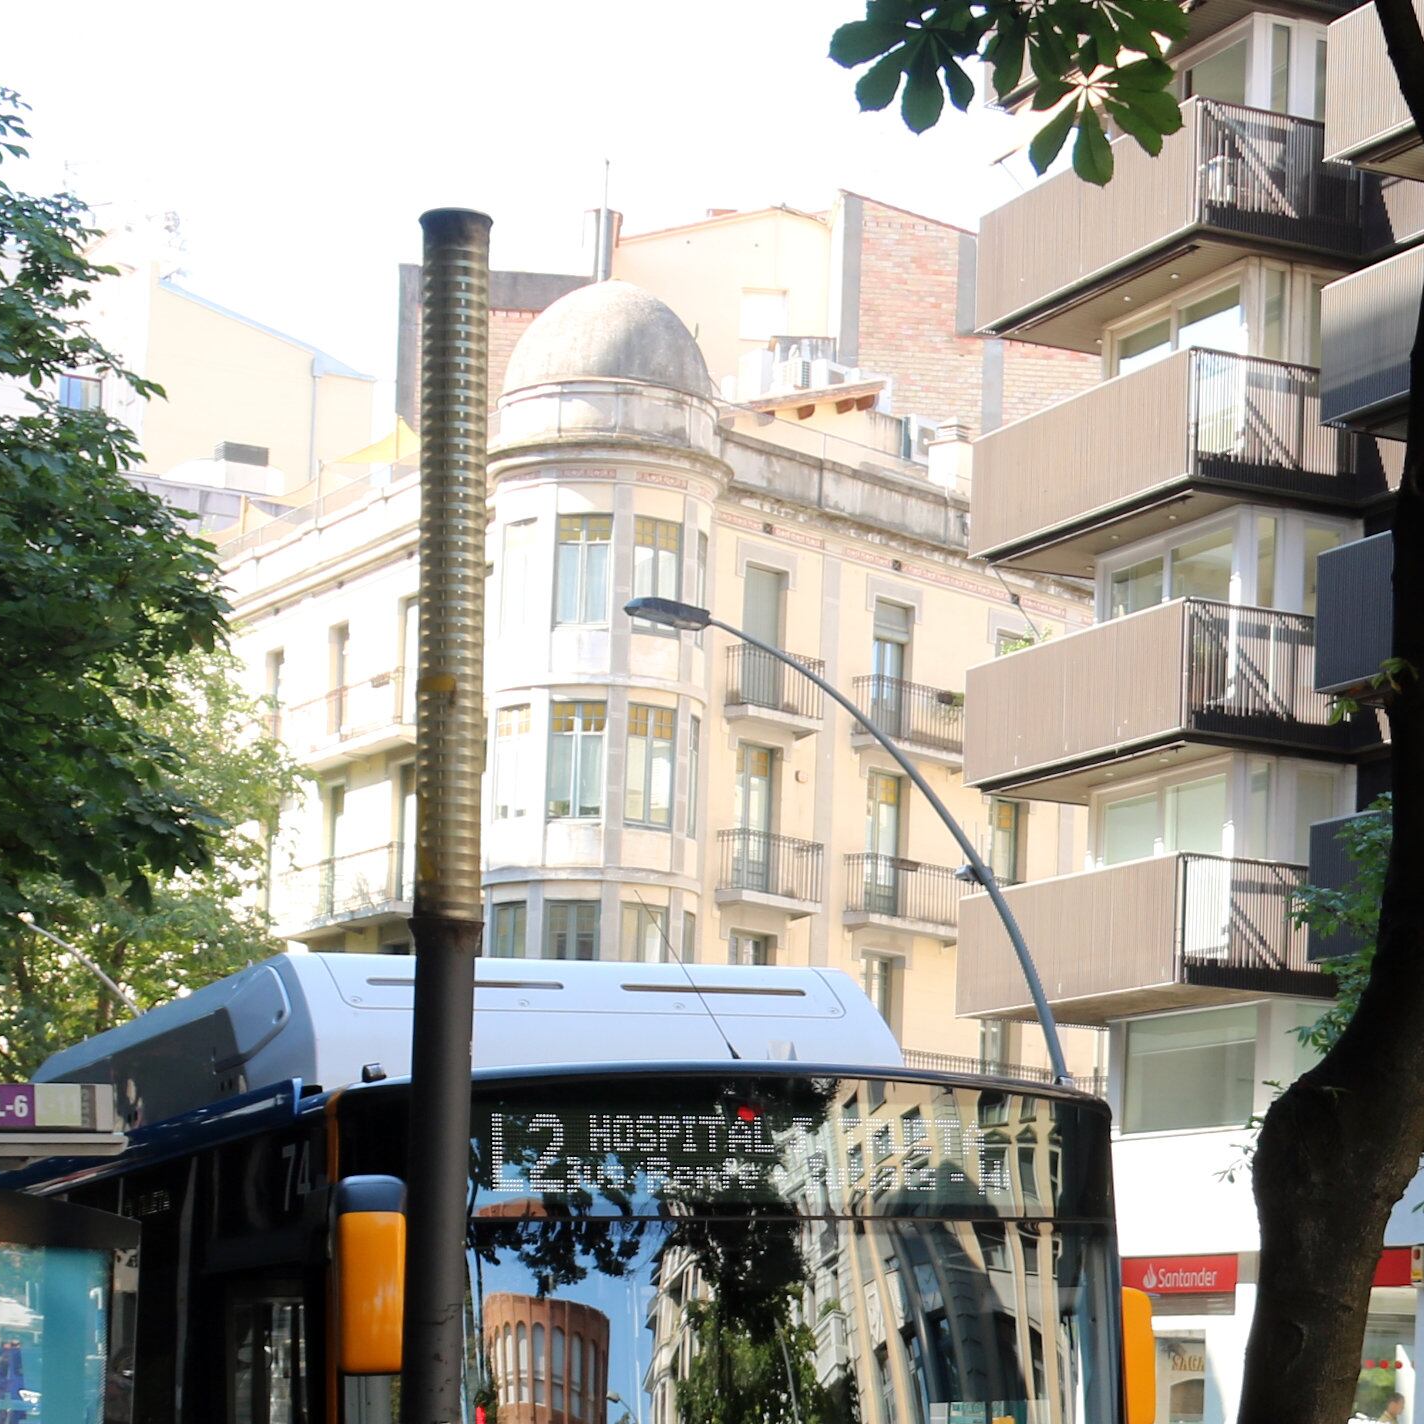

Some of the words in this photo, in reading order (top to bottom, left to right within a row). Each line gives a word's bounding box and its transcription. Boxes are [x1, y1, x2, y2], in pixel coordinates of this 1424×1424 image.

[491, 1112, 564, 1192] L2
[589, 1114, 775, 1153] HOSPITAL
[1157, 1266, 1218, 1289] Santander
